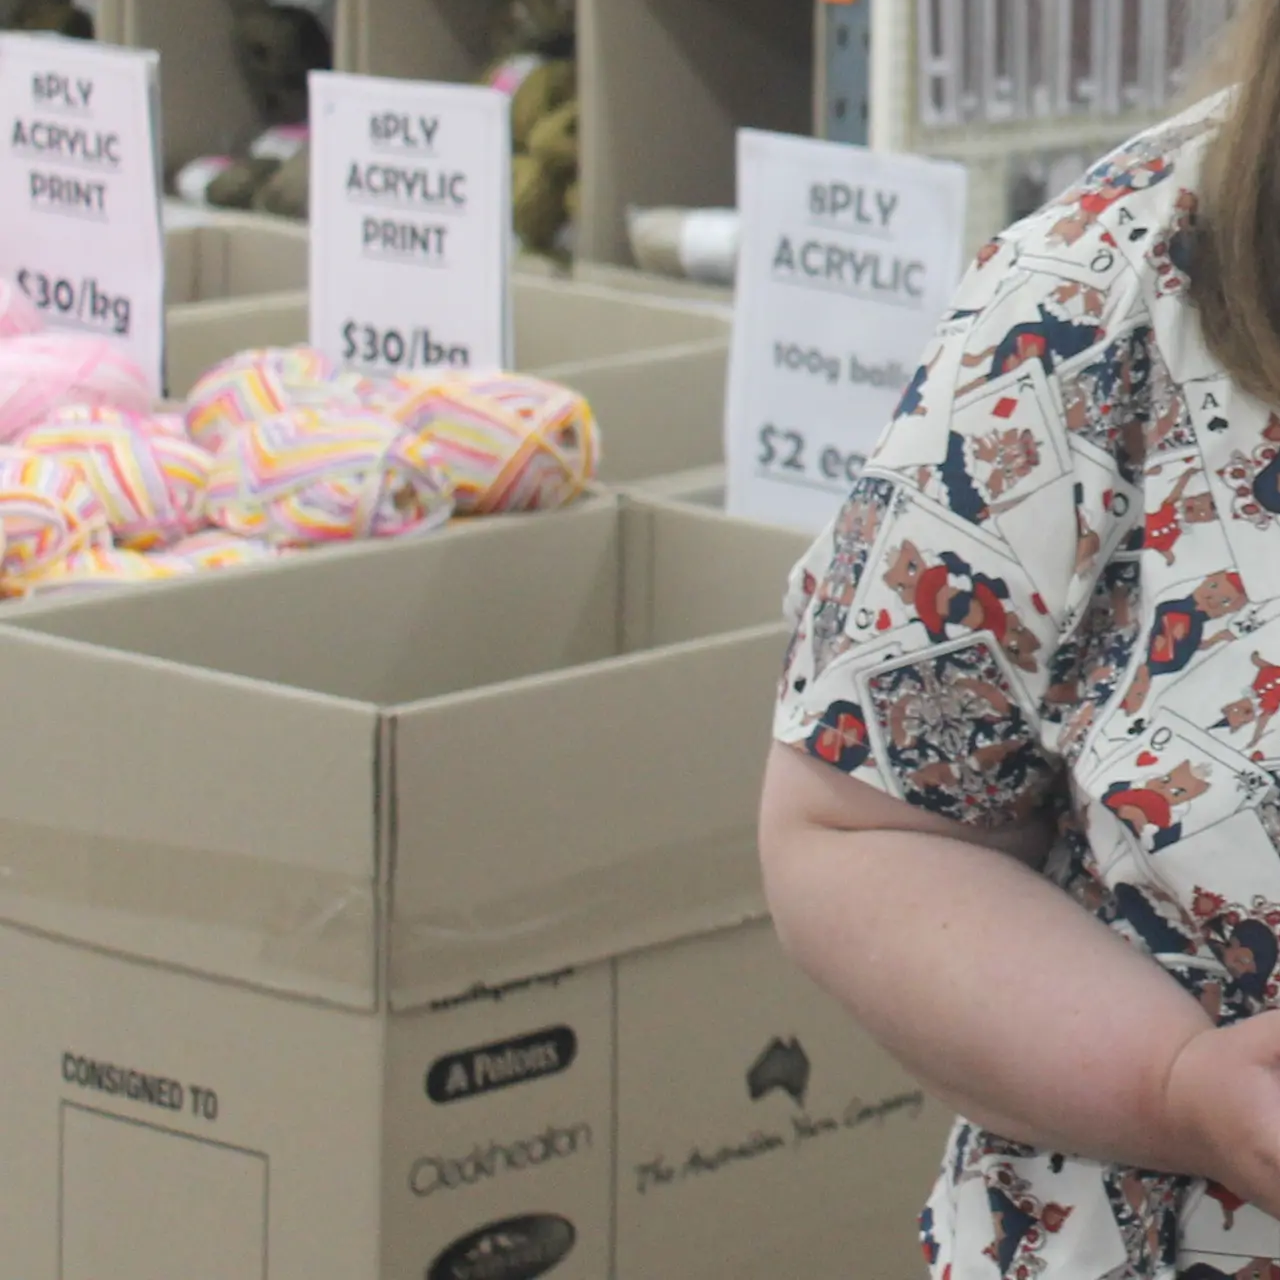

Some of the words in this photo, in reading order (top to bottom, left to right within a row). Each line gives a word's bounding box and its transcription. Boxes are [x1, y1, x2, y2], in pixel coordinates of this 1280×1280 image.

[12, 119, 121, 167] ACRYLIC
[29, 171, 107, 211] PRINT
[346, 162, 467, 205] ACRYLIC
[361, 215, 449, 257] PRINT
[772, 236, 928, 298] ACRYLIC
[1202, 392, 1220, 410] A
[758, 423, 807, 474] $2
[1150, 725, 1173, 752] Q
[61, 1051, 185, 1112] CONSIGNED
[189, 1083, 219, 1121] TO
[472, 1040, 559, 1089] Patons
